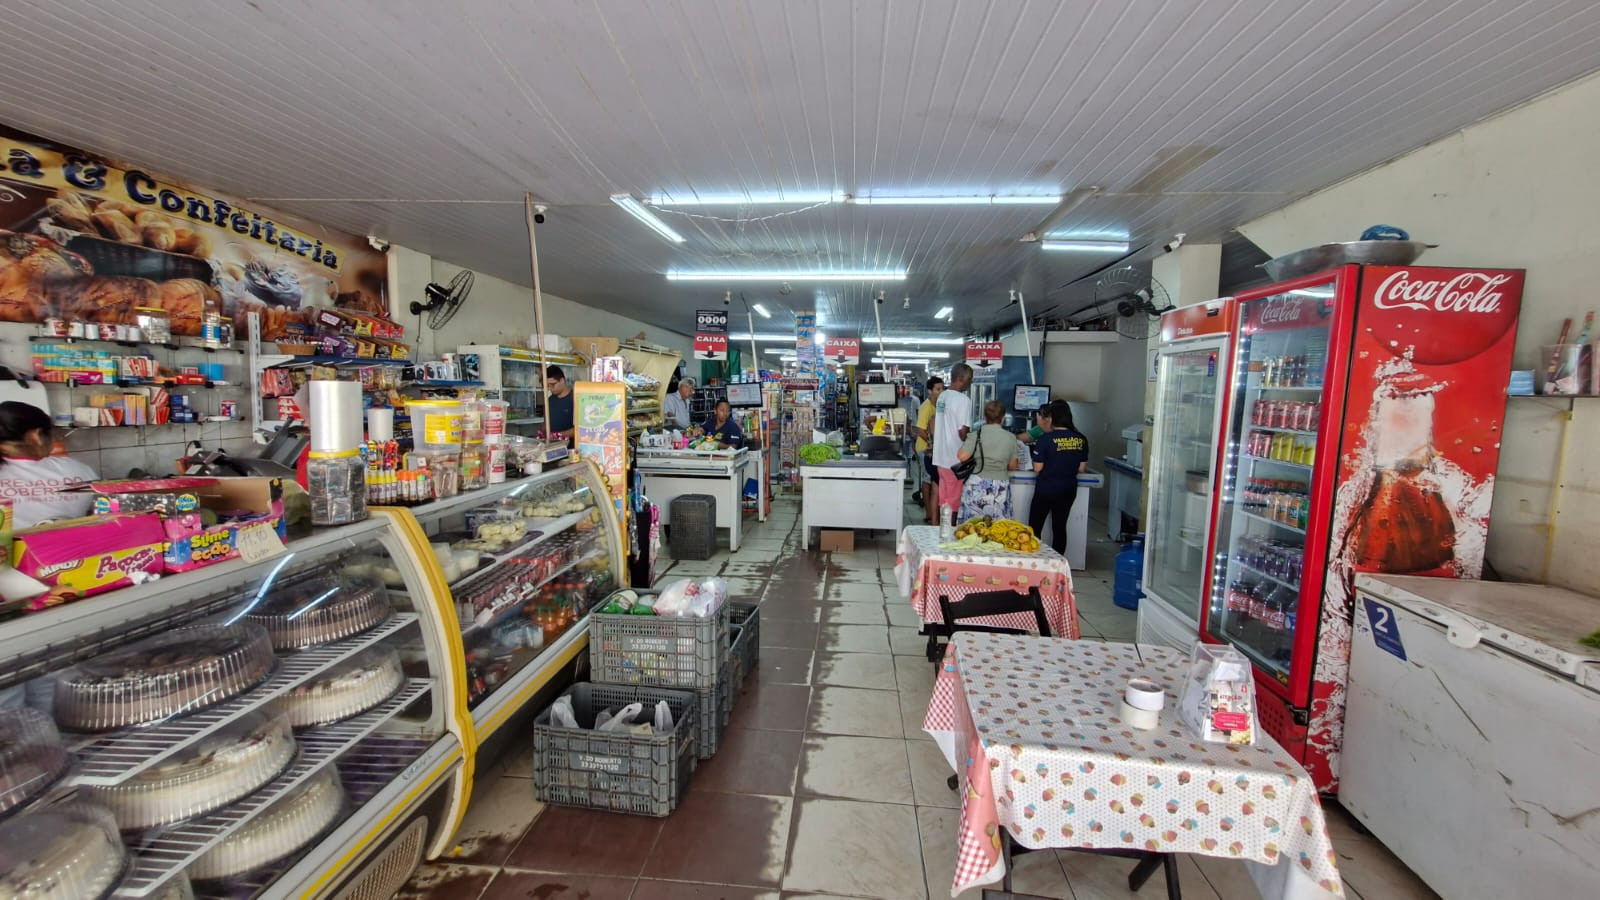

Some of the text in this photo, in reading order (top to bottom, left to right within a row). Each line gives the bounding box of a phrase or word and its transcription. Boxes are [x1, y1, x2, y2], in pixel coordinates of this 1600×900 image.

[124, 170, 338, 270] Confeitaria
[1374, 270, 1512, 313] Coca-Cola
[696, 335, 726, 343] CAIXA
[1375, 607, 1388, 634] 2
